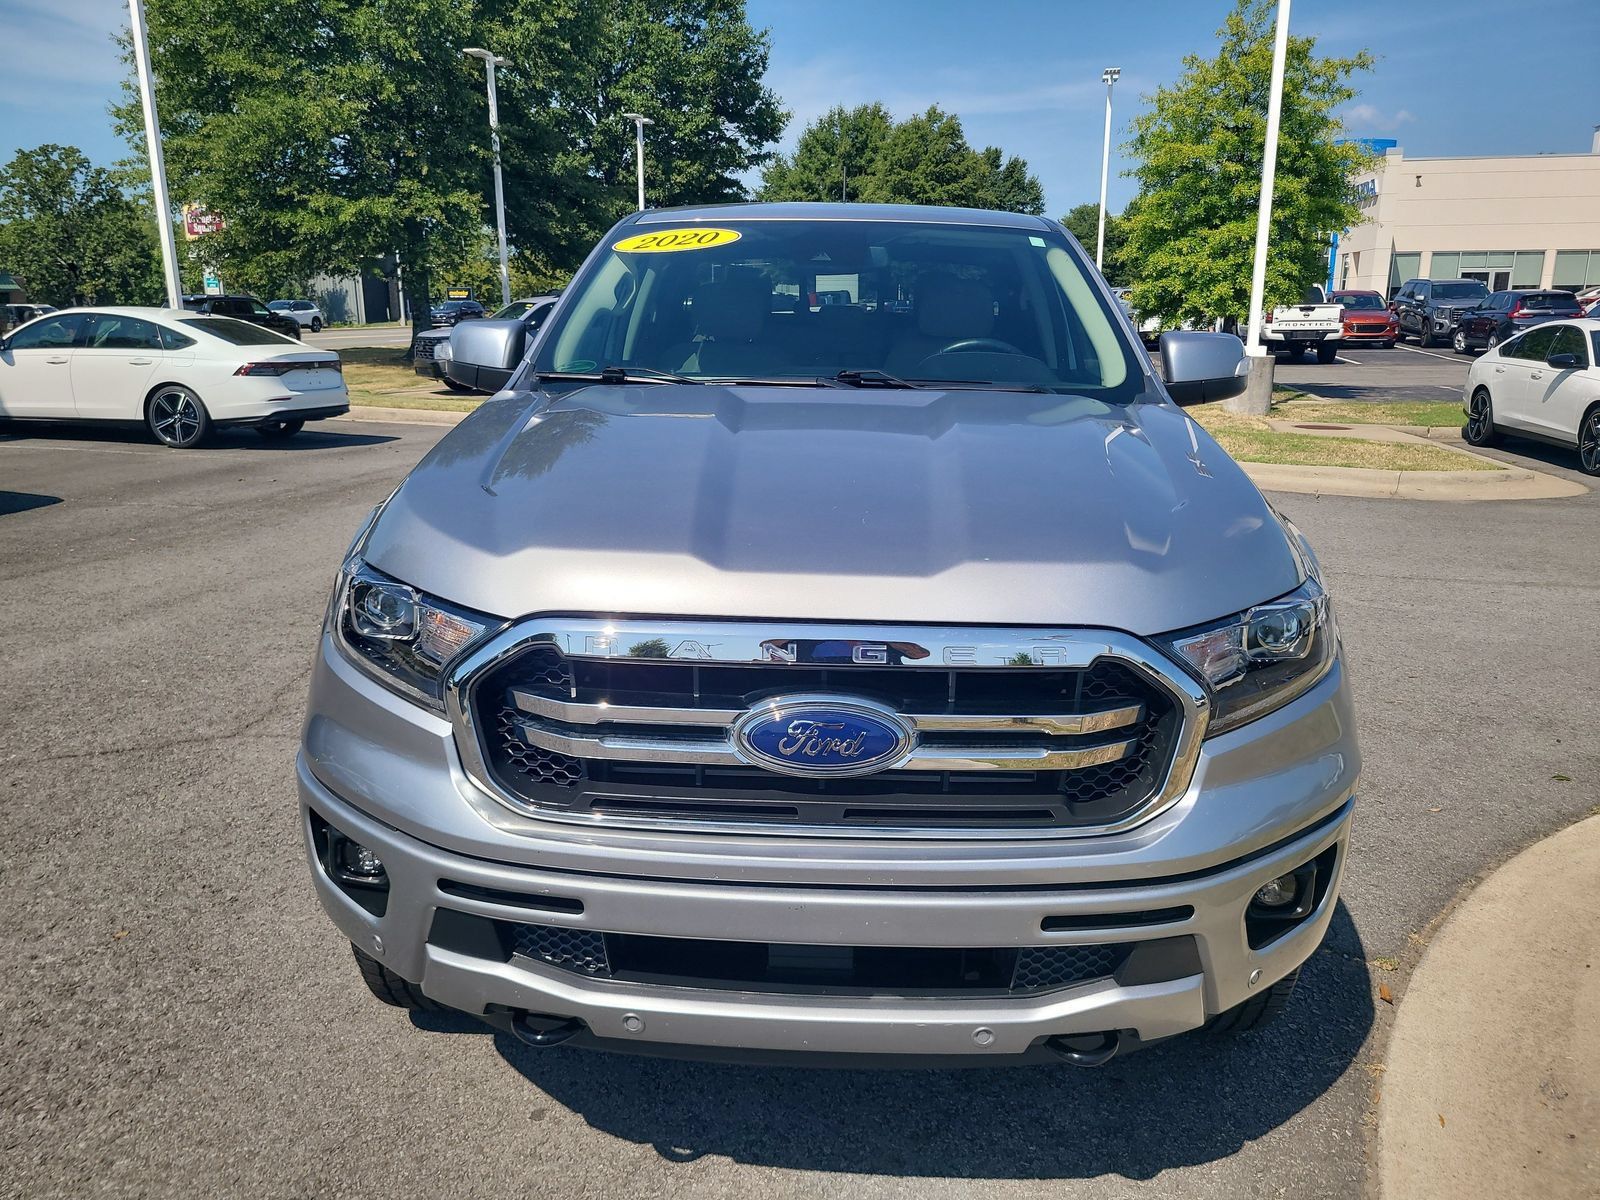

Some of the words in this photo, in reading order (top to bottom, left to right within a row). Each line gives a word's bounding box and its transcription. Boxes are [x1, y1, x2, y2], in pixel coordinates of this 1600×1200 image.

[632, 231, 720, 250] 2020
[585, 636, 1067, 665] RANGER
[778, 719, 867, 758] Ford
